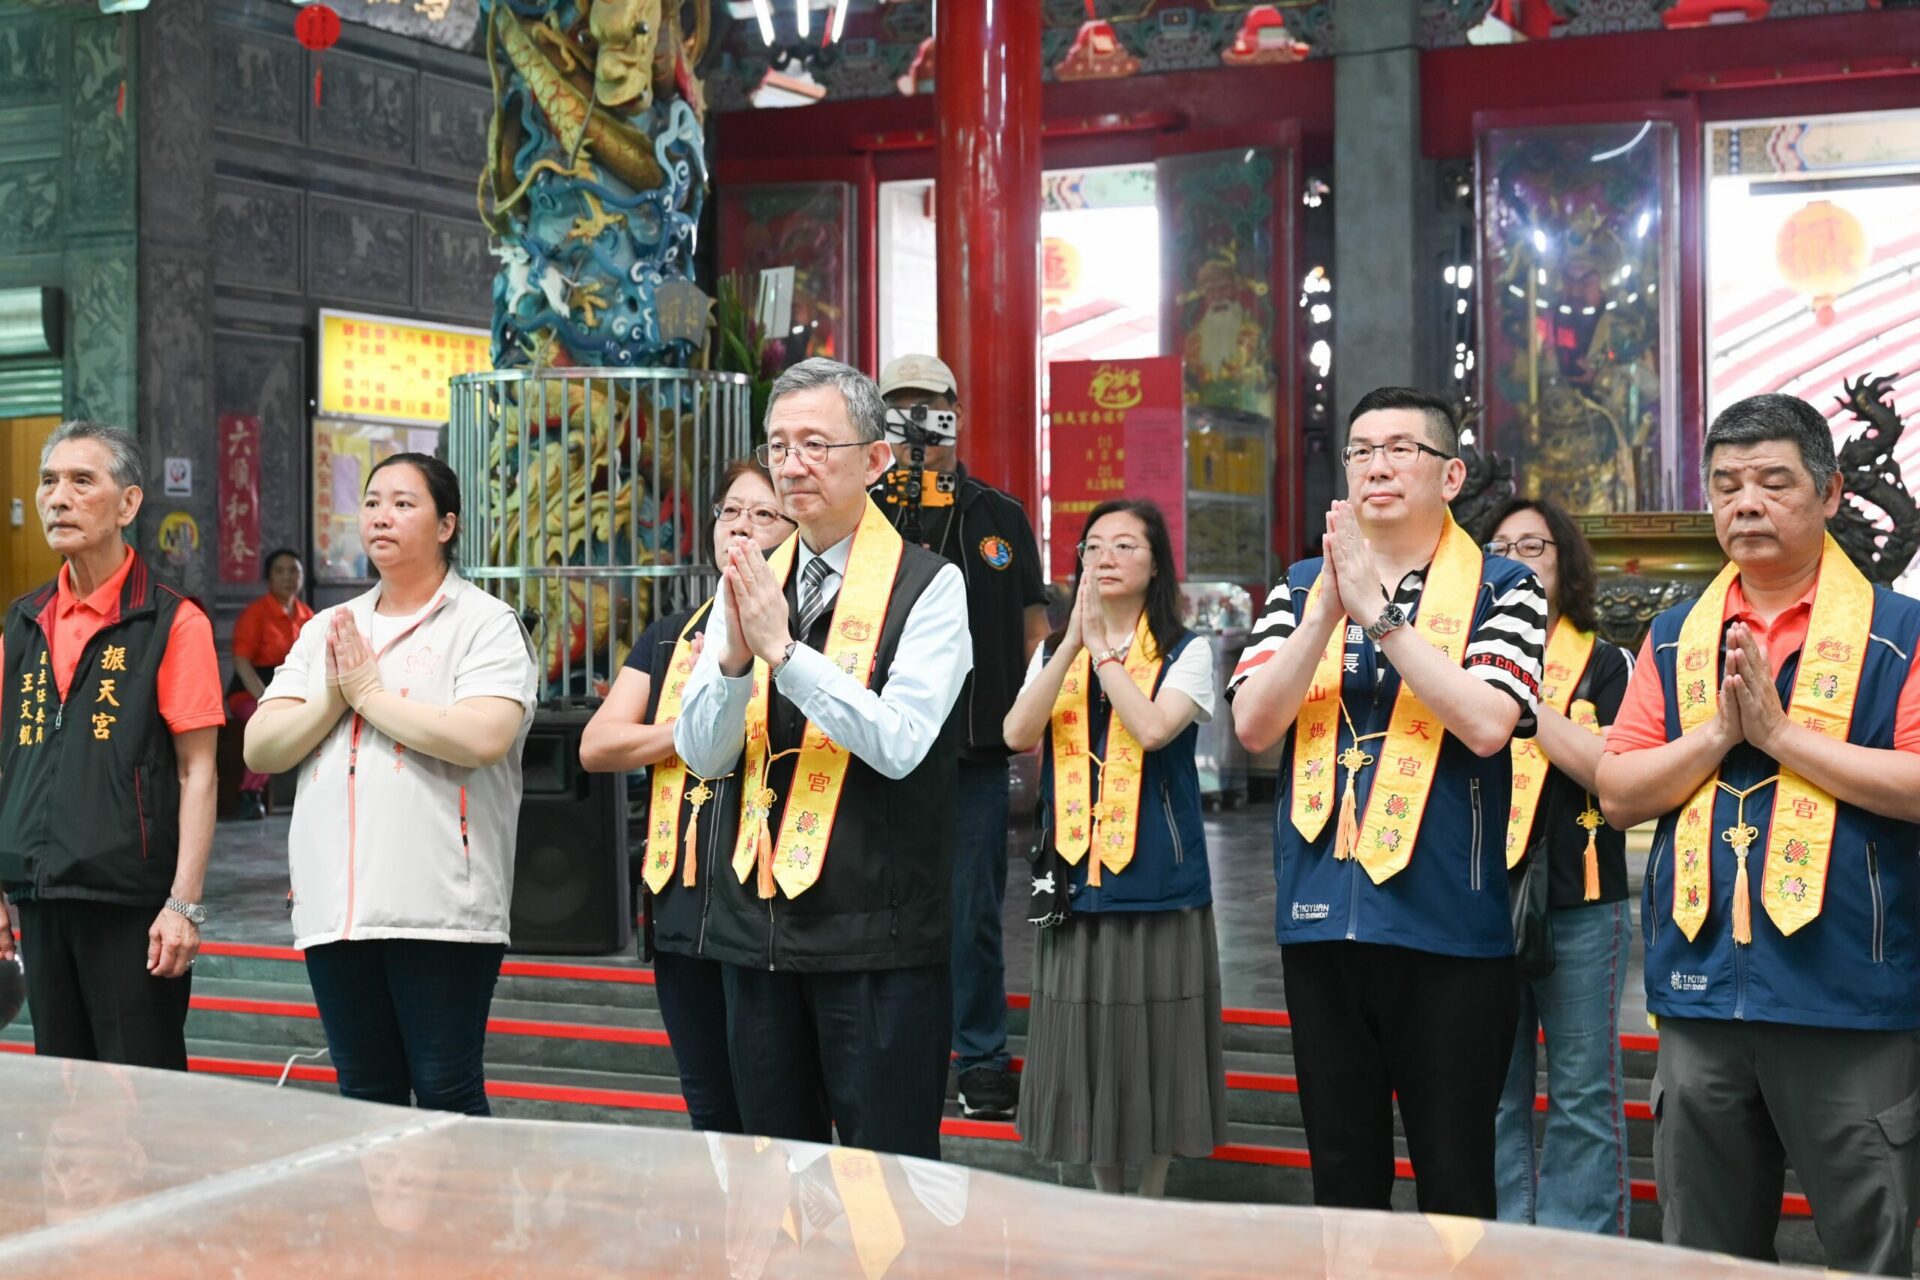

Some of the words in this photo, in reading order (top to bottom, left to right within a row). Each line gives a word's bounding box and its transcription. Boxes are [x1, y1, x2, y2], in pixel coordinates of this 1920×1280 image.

[1343, 625, 1364, 674] 區長
[1471, 654, 1492, 666] LE
[19, 673, 34, 745] 王文凱
[91, 645, 126, 740] 振天宮
[1062, 710, 1082, 785] 龜山媽
[1113, 722, 1132, 792] 天宮
